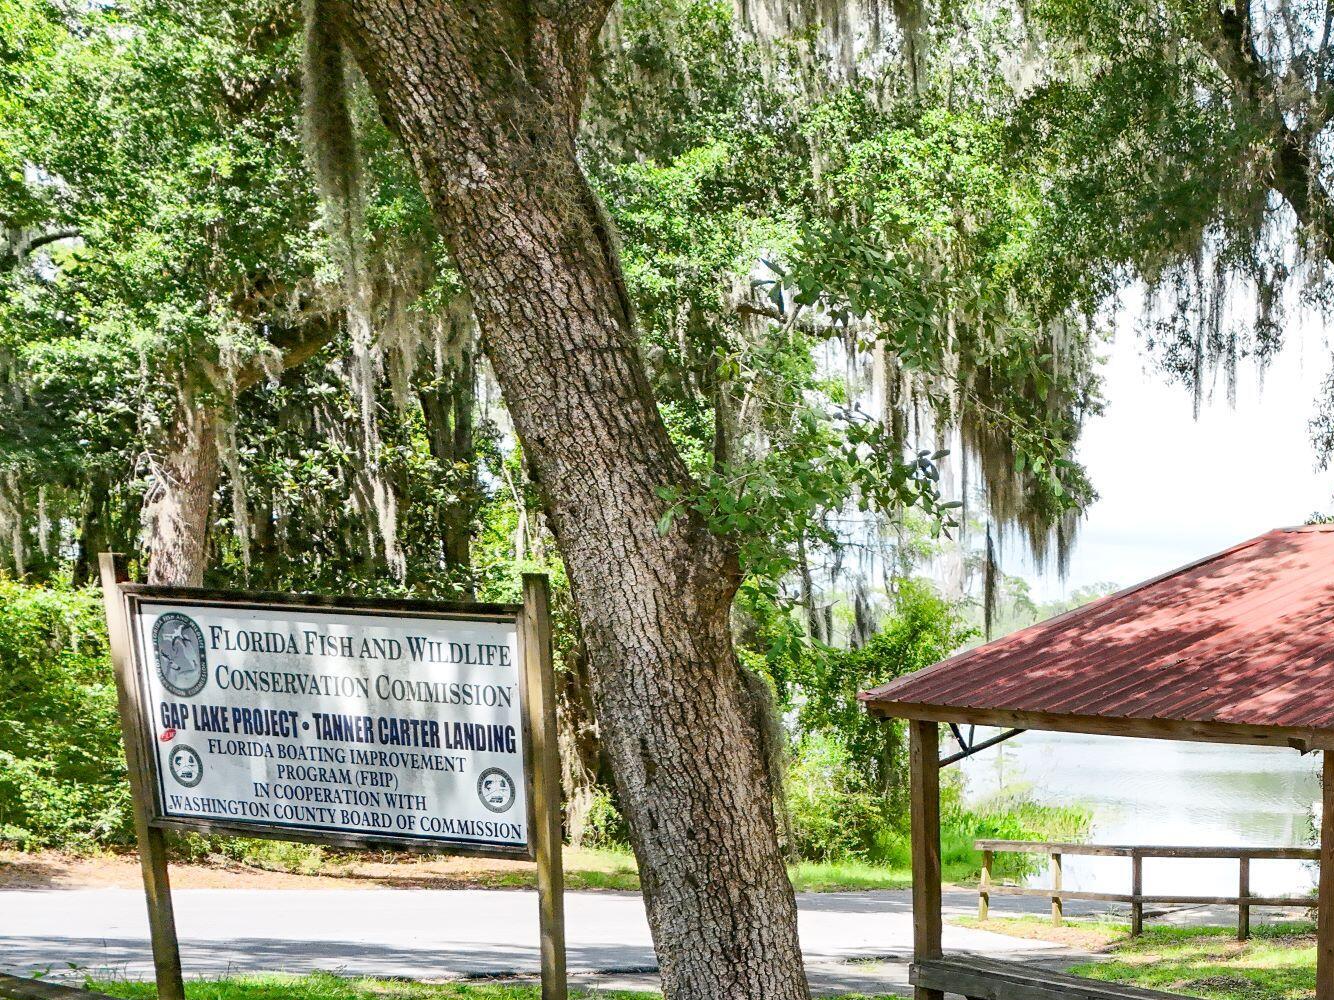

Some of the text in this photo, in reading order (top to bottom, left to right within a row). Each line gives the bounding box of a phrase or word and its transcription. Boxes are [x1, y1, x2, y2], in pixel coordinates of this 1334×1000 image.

[208, 625, 512, 667] FLORIDA FISH AND WILDLIFE
[215, 664, 512, 708] CONSERVATION COMMISSION
[160, 701, 517, 754] GAP LAKE PROJECT TANNER CARTER LANDING
[207, 738, 467, 773] FLORIDA BOATING IMPROVEMENT
[253, 782, 428, 811] IN COOPERATION WITH
[277, 763, 398, 791] PROGRAM (FBIP)
[170, 794, 522, 840] WASHINGTON COUNTY BOARD OF COMMISSION
